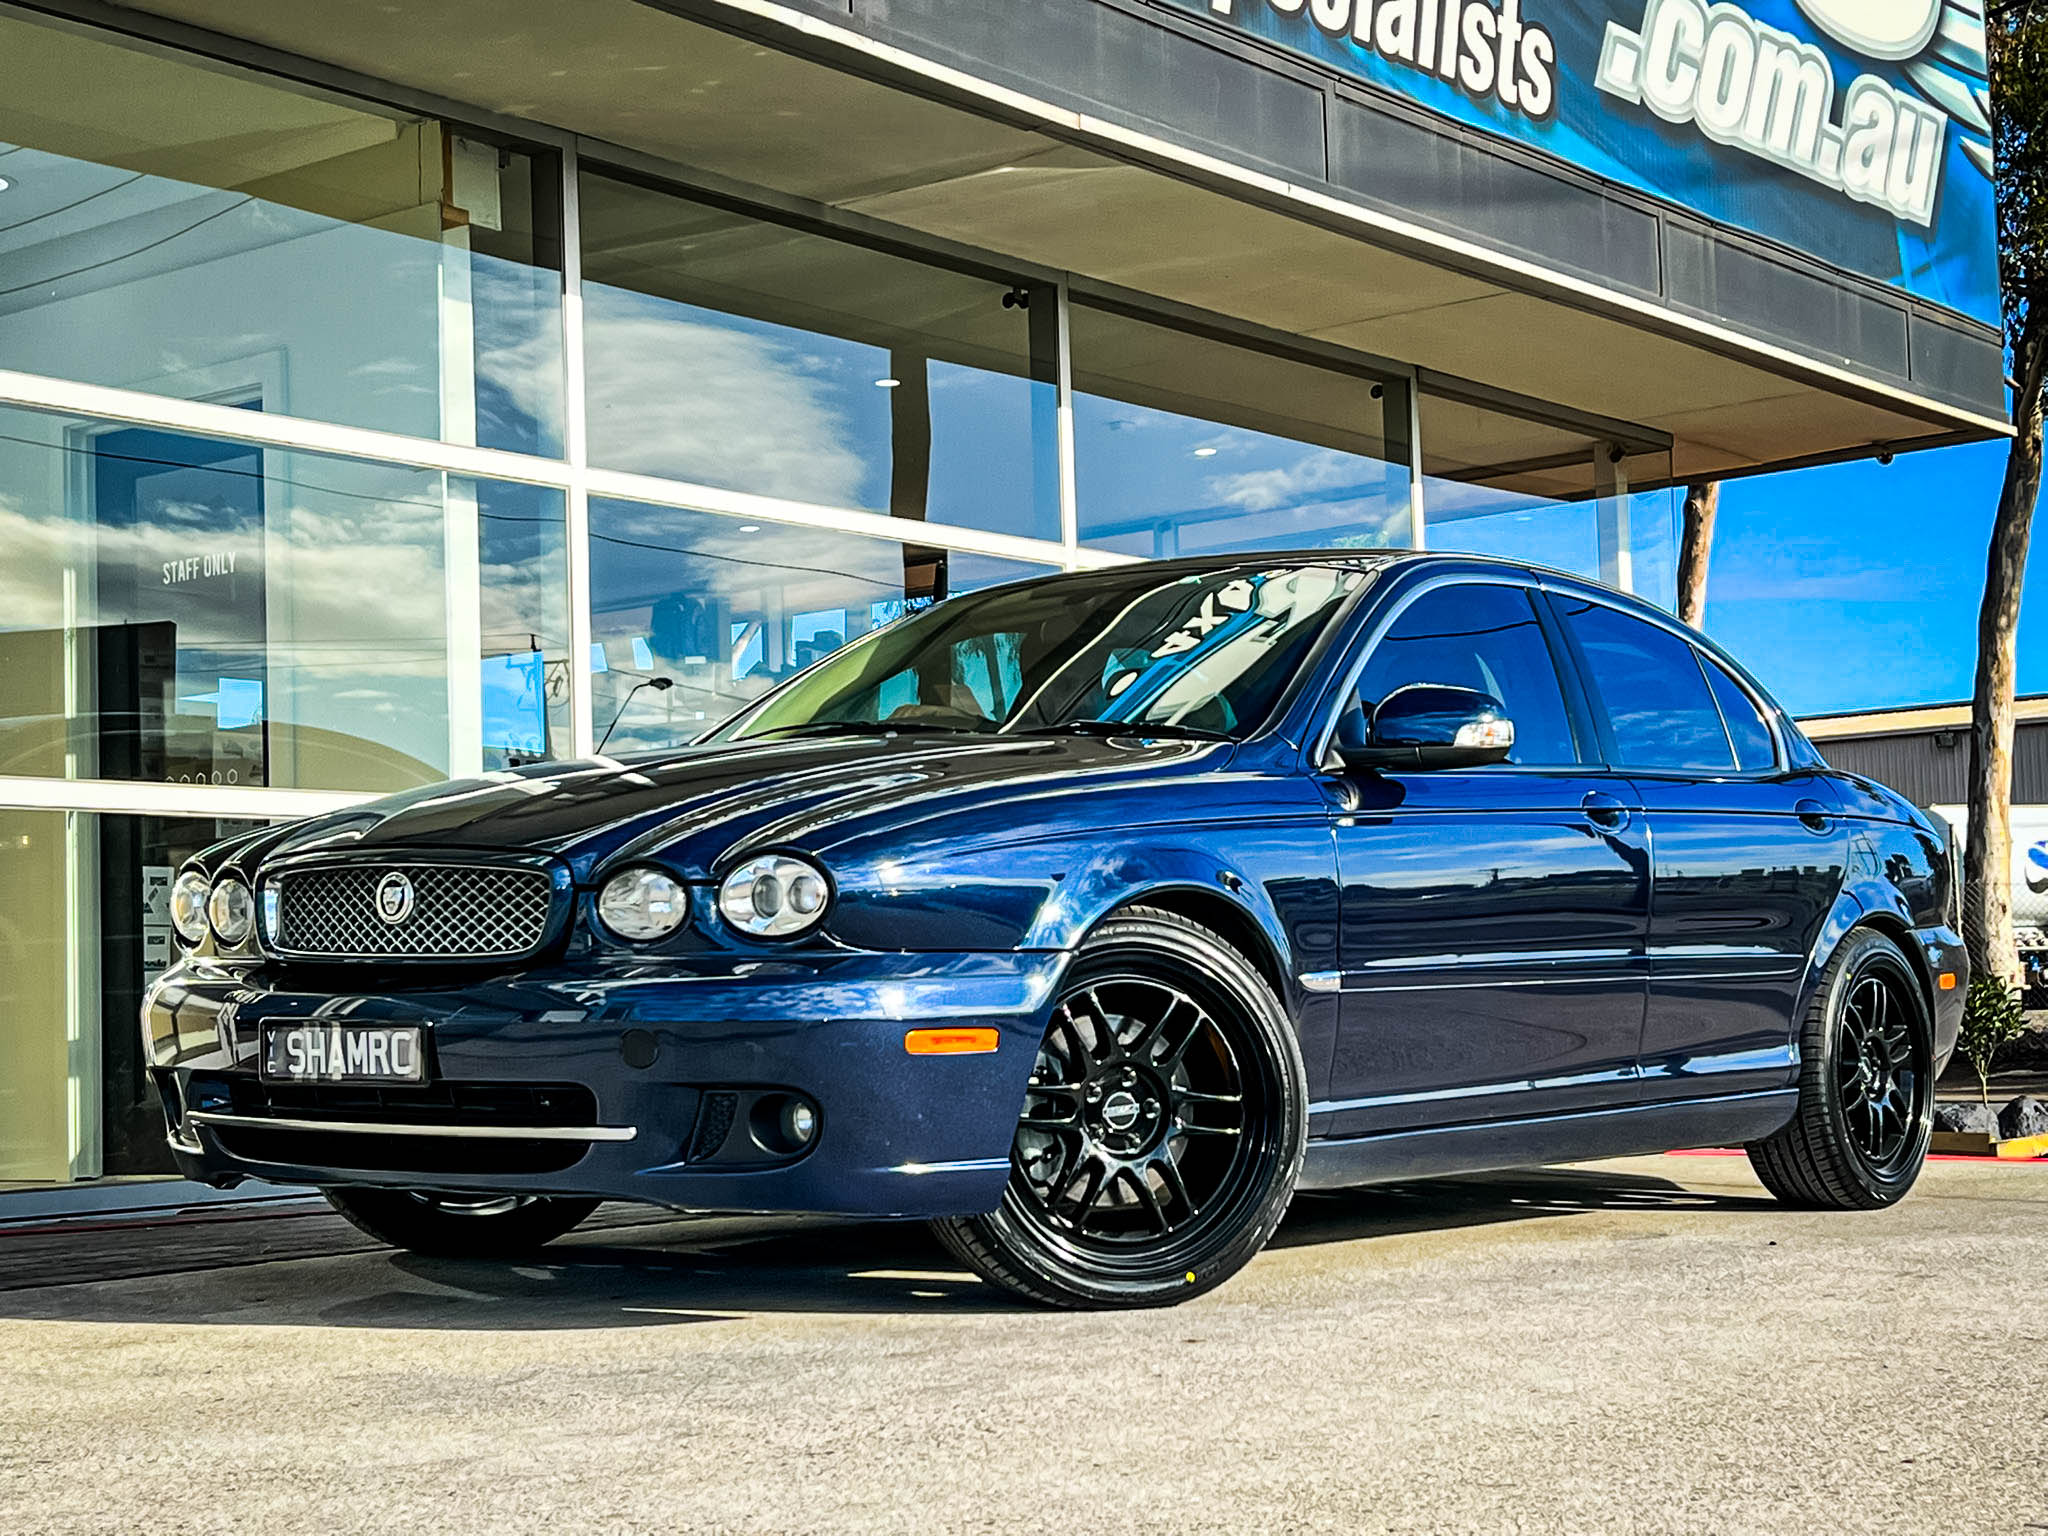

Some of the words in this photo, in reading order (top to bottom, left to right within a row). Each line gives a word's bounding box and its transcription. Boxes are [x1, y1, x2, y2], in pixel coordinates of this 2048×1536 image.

[1596, 0, 1946, 226] .com.au
[162, 556, 200, 585] STAFF
[203, 551, 236, 577] ONLY
[267, 1031, 276, 1073] VIC
[286, 1030, 413, 1075] SHAMRC
